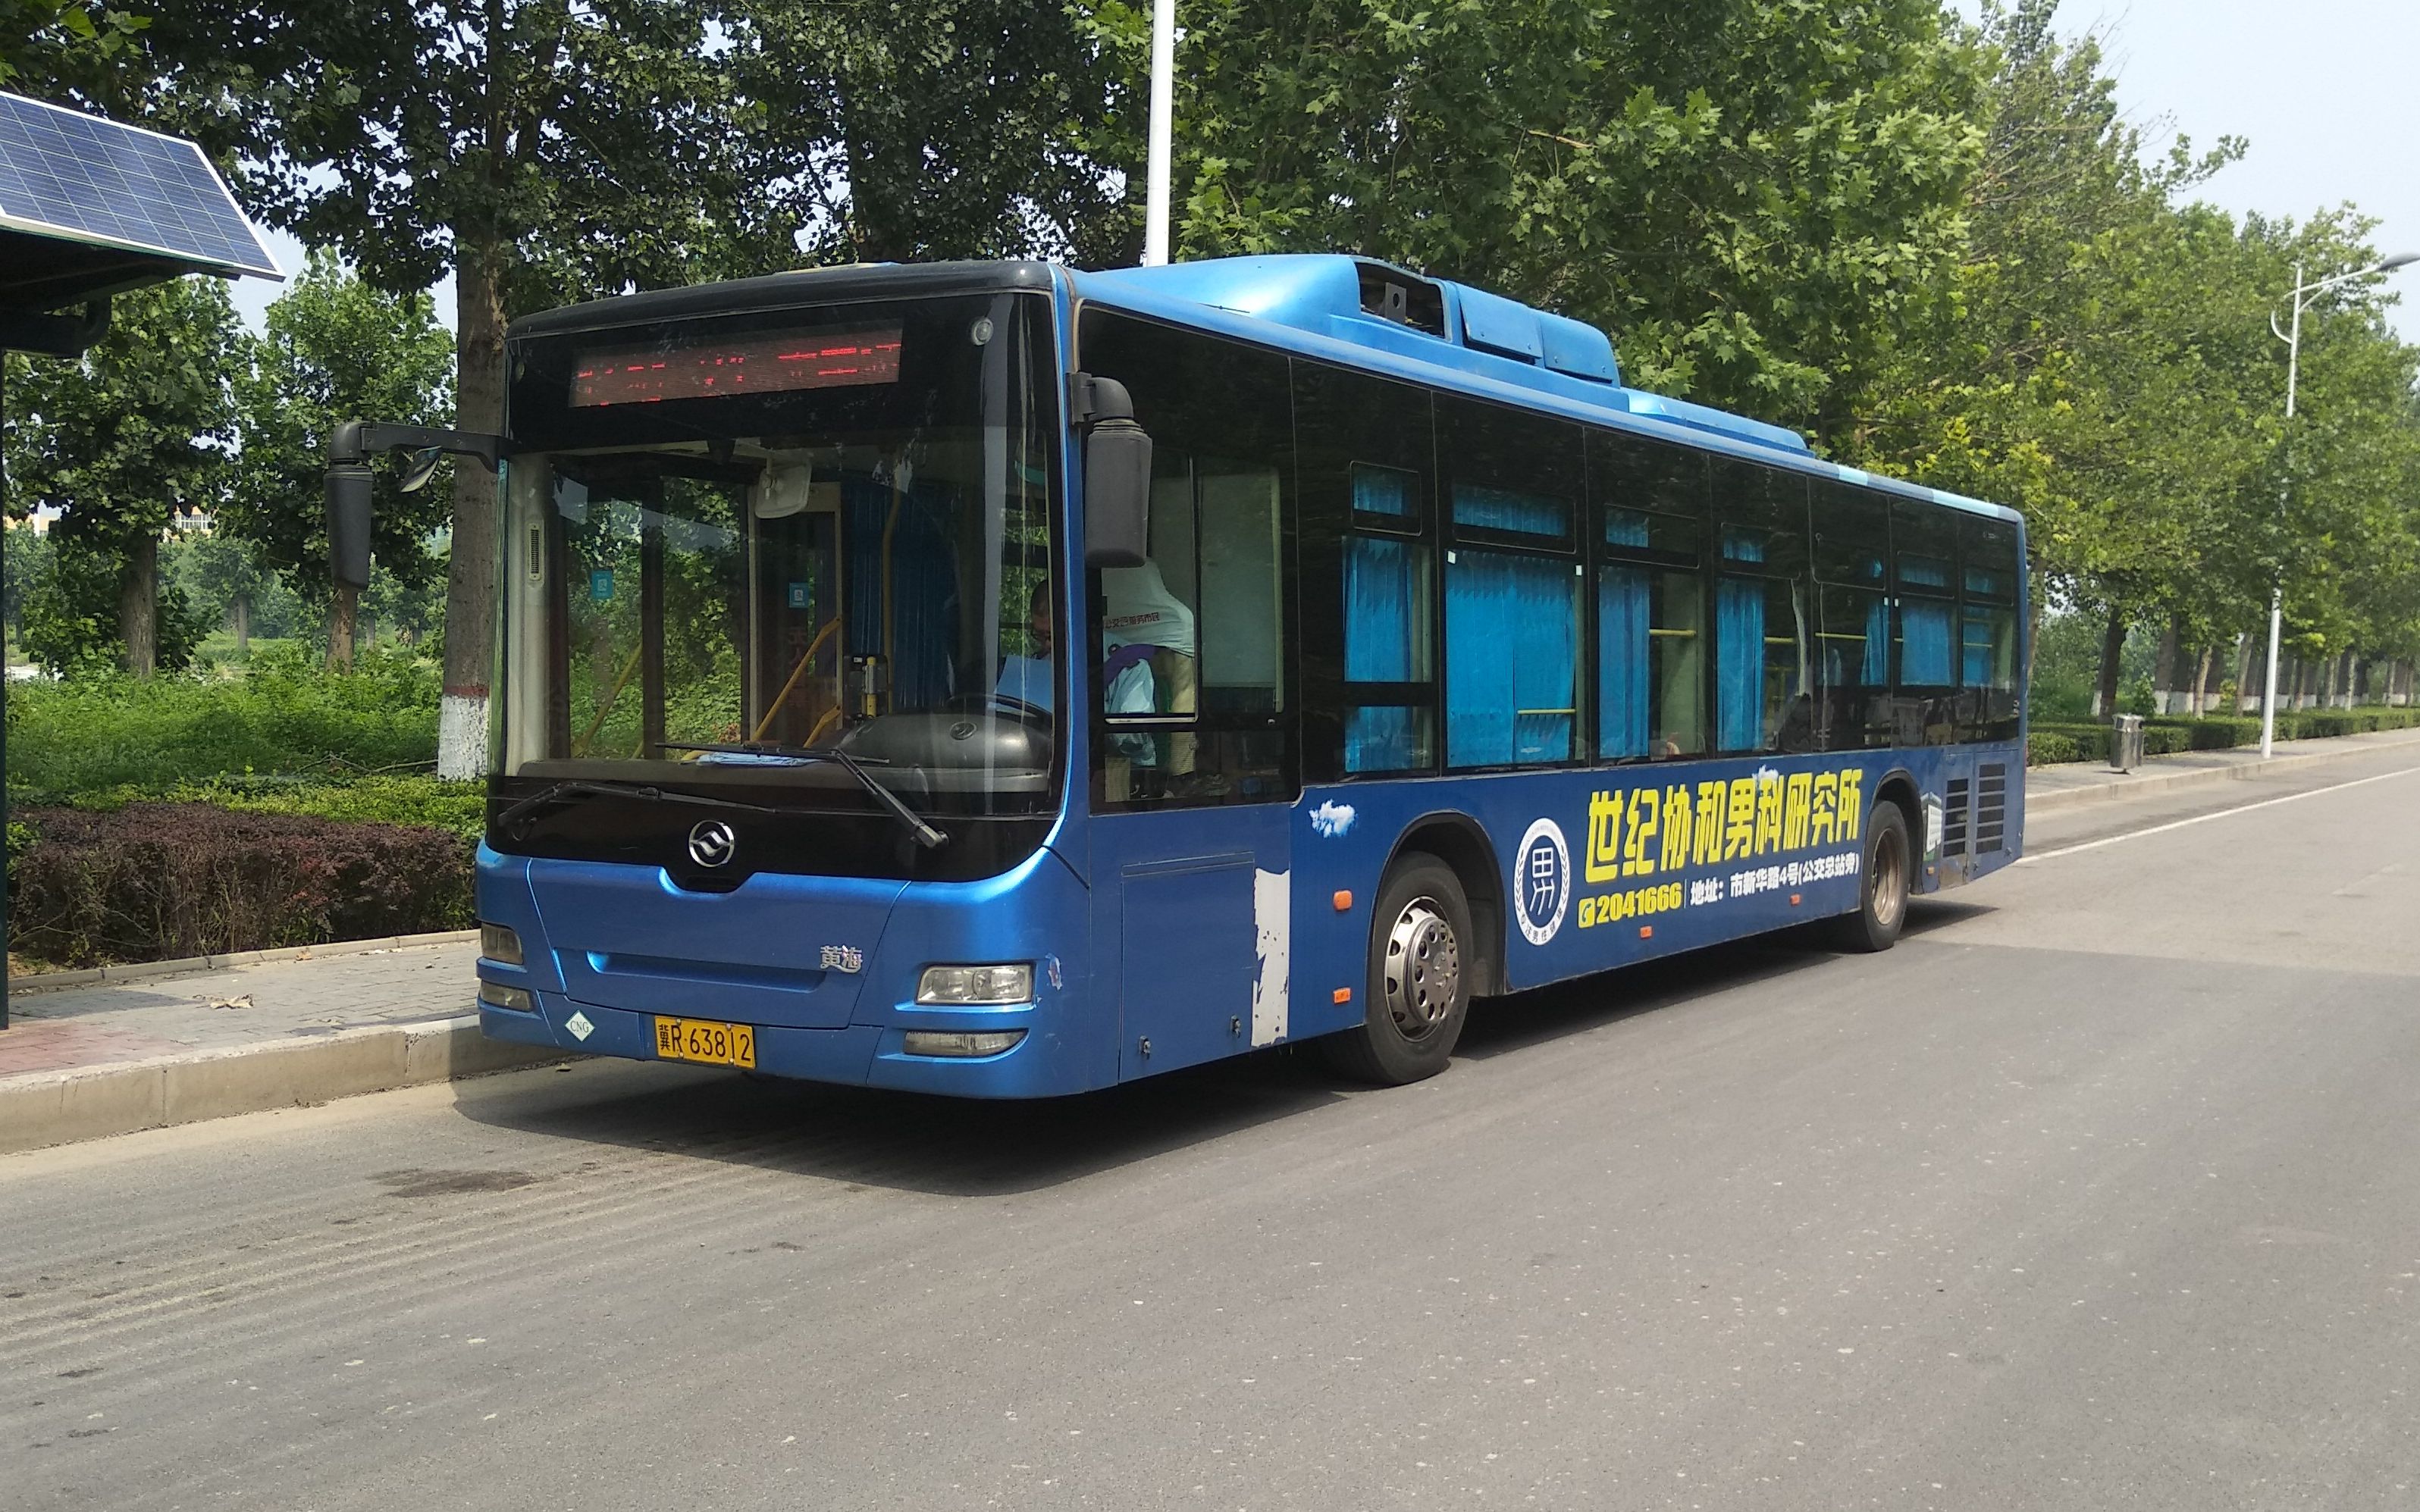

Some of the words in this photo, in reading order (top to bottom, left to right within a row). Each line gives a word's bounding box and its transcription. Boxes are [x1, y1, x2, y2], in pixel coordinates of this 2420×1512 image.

[1585, 769, 1862, 883] 世纪协和男科研究所
[1597, 882, 1682, 924] 2041666
[820, 944, 864, 973] 黄海
[570, 1020, 590, 1033] CNG
